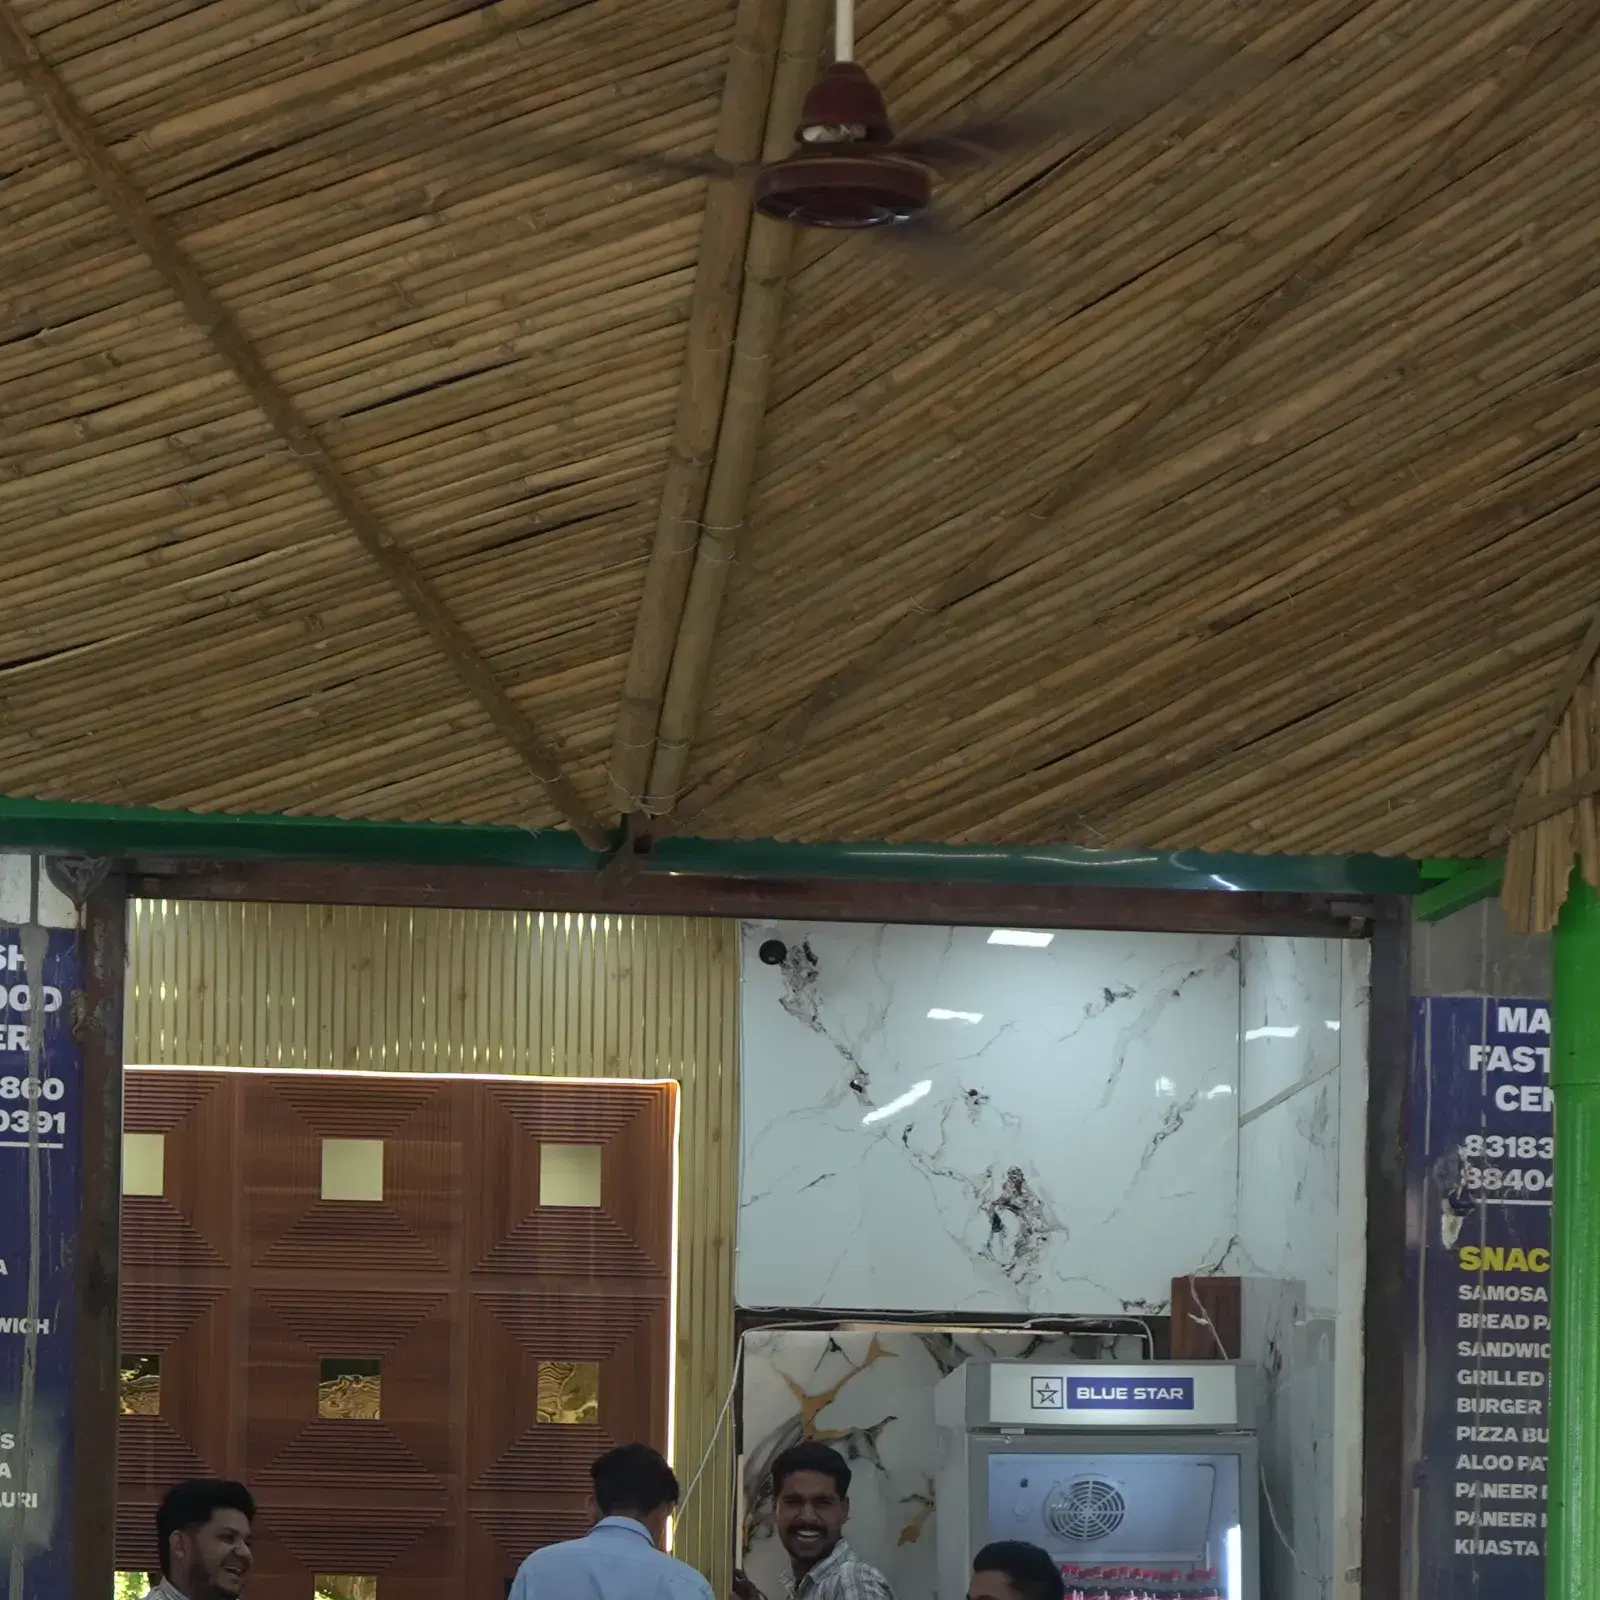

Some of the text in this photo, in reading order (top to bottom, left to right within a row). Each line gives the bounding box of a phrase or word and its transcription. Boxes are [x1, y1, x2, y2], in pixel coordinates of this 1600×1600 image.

[1458, 1284, 1549, 1303] SAMOSA
[1457, 1312, 1530, 1330] BREAD
[1457, 1340, 1551, 1359] SANDWIC
[1457, 1369, 1545, 1387] GRILLED
[1076, 1386, 1185, 1400] BLUE STAR
[1456, 1397, 1543, 1415] BURGER
[1456, 1425, 1519, 1443] PIZZA
[1455, 1453, 1514, 1471] ALOO
[1455, 1482, 1538, 1500] PANEER
[1454, 1510, 1538, 1528] PANEER
[1454, 1538, 1540, 1556] KHASTA
